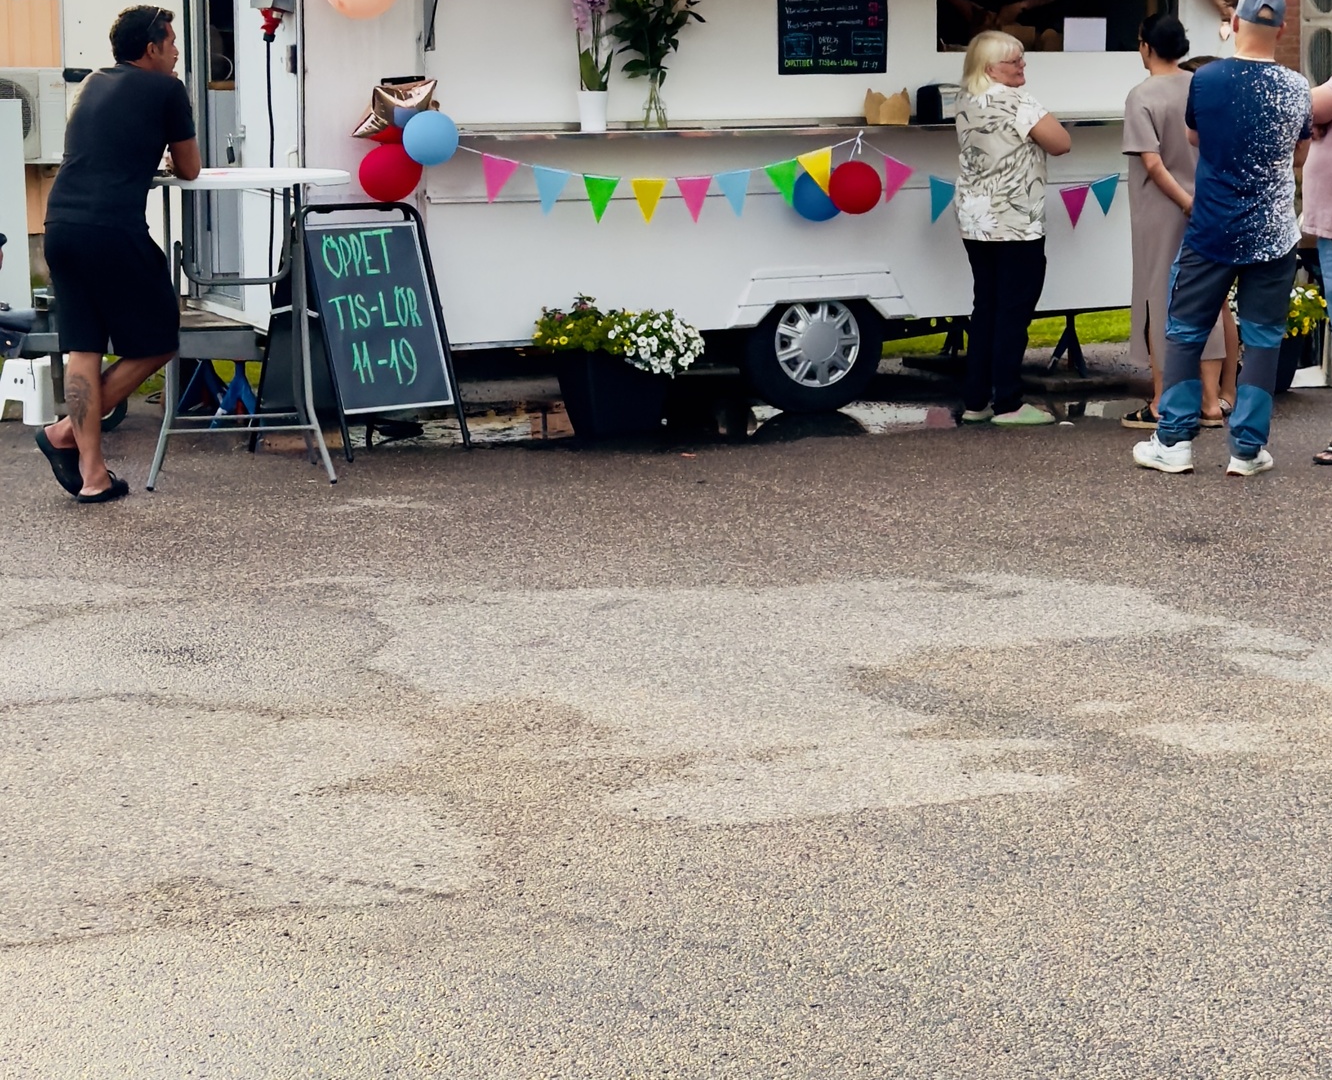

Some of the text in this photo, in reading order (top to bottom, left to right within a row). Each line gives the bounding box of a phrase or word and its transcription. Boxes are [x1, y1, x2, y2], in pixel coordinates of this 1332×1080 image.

[321, 228, 393, 278] ÖPPET
[328, 285, 423, 331] TIS-LÖR
[352, 337, 418, 386] 11-19
